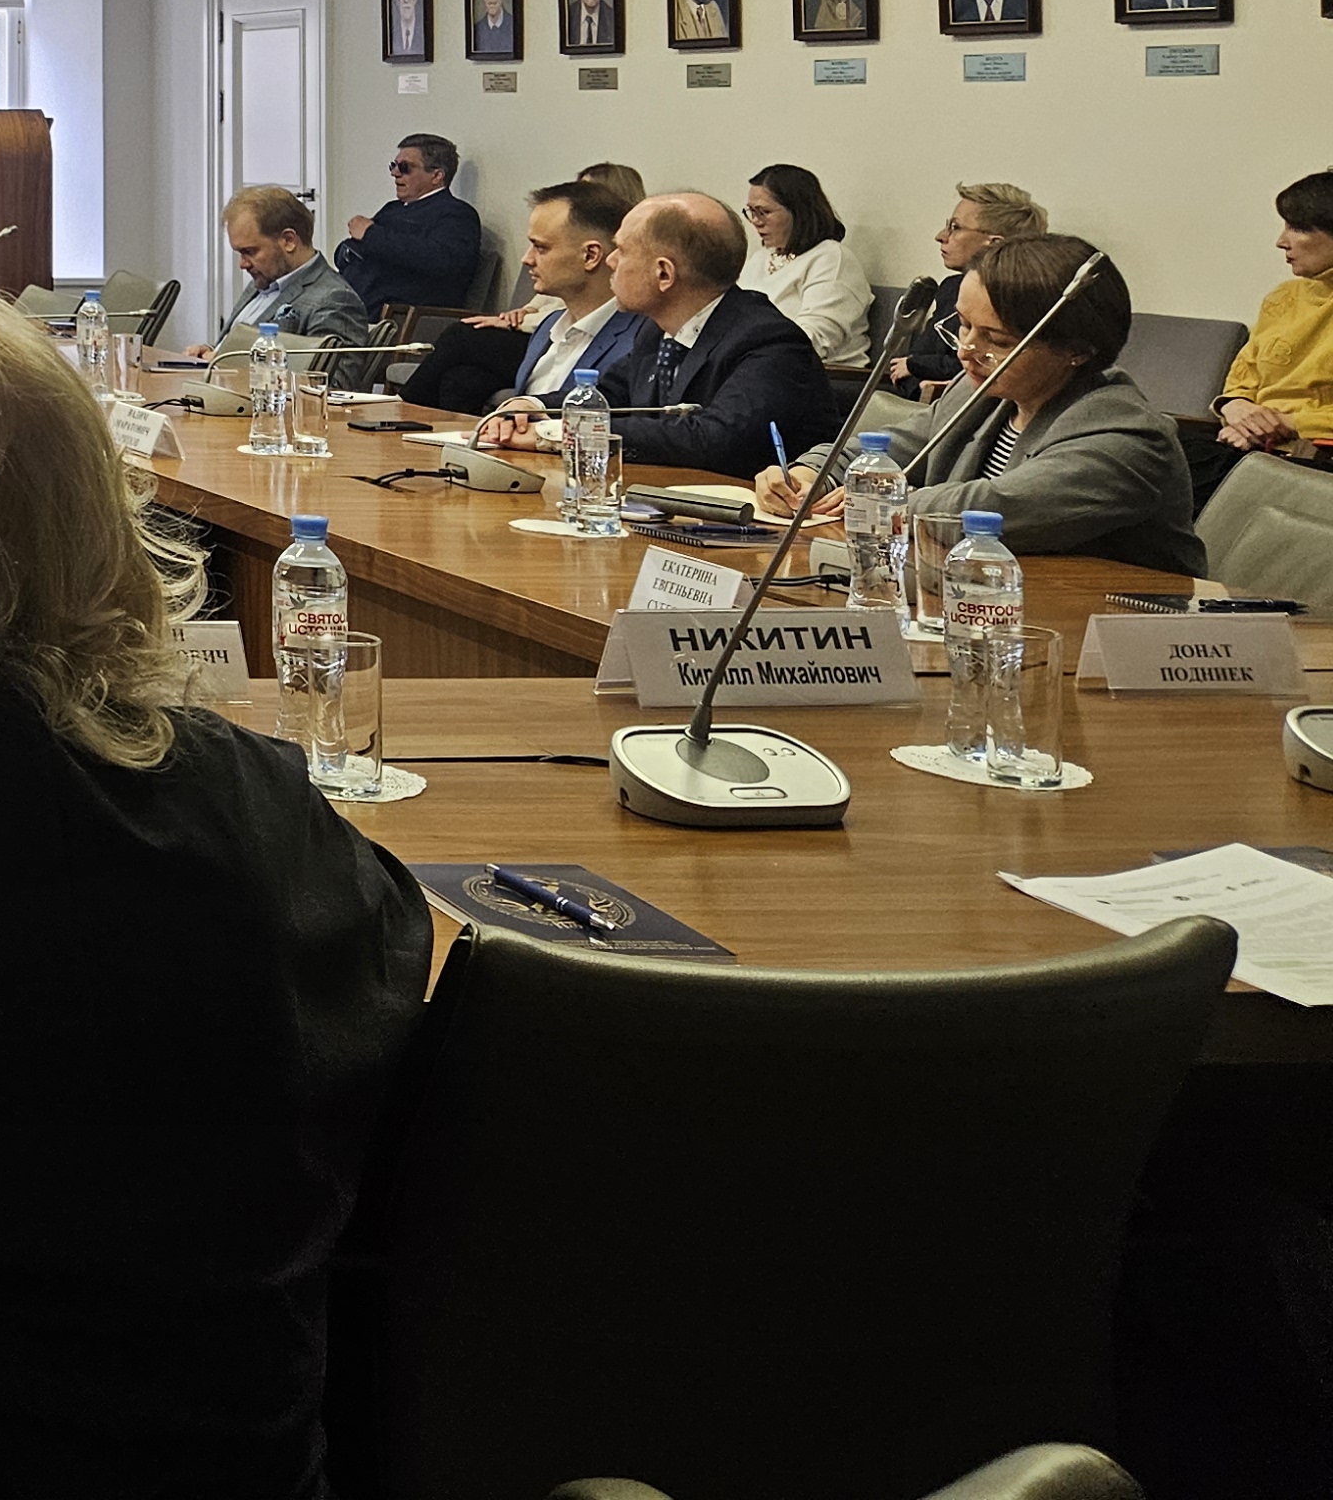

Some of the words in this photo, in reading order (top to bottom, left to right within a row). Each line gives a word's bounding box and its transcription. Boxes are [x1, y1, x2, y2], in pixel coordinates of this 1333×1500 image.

[662, 559, 718, 586] ЕКАТЕРИНА
[652, 577, 713, 606] ЕВГЕНЬЕВНА
[957, 602, 1014, 617] СВЯТОЙ
[669, 626, 873, 652] НИКИТИН
[1169, 643, 1232, 660] ДОНАТ
[756, 661, 882, 685] Михайлович
[1160, 666, 1254, 683] ПОДНИЕК
